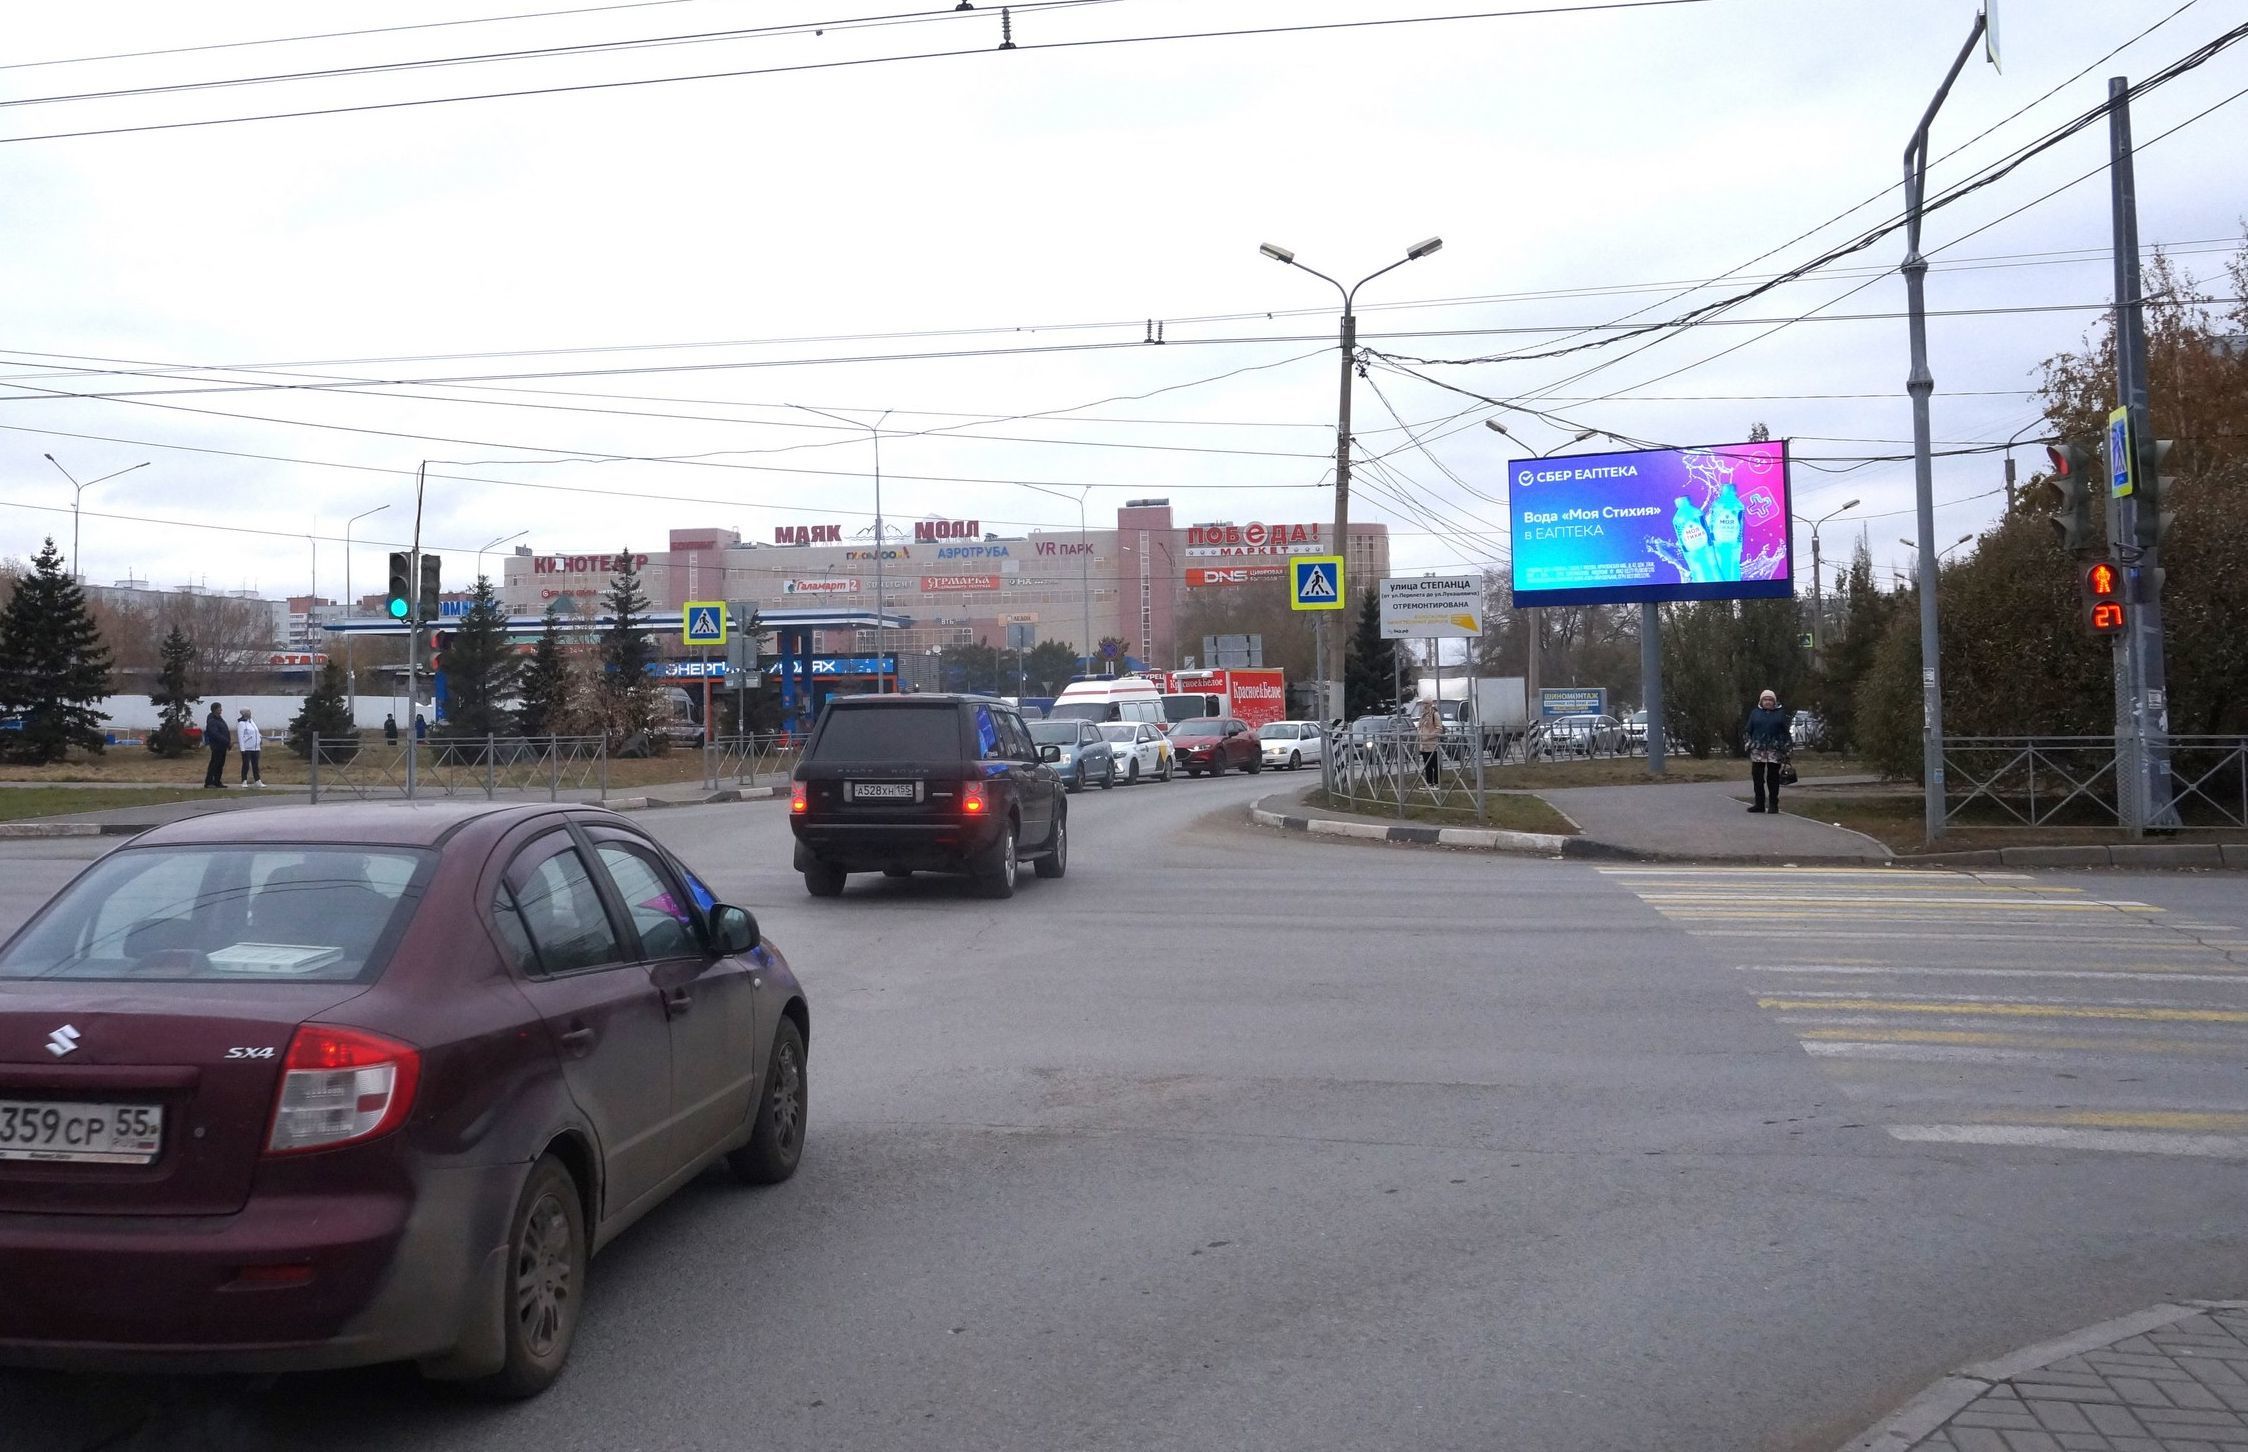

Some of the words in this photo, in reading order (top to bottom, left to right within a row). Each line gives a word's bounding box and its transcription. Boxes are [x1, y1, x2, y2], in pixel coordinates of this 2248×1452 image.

[1536, 471, 1573, 482] СБЕР
[1574, 465, 1638, 480] ЕАПТЕКА
[1523, 511, 1558, 524] Вода
[1562, 508, 1599, 521] «Моя
[1602, 505, 1661, 519] Стихия»
[775, 525, 842, 543] МАЯК
[914, 520, 980, 540] МОЛЛ
[1535, 524, 1605, 540] ЕАПТЕКА
[938, 546, 1009, 559] АЭРОТРУБА
[1035, 542, 1056, 555] VR
[1059, 543, 1094, 555] ПАРК
[1221, 547, 1289, 556] МАРКЕТ
[1204, 570, 1248, 583] DNS
[1390, 584, 1418, 592] улица
[1420, 581, 1471, 590] СТЕПАНЦА
[1392, 602, 1469, 610] ОТРЕМОНТИРОВАНА
[2095, 605, 2122, 627] 27
[1544, 692, 1599, 700] ШИНОМОНТАЖ
[223, 1046, 276, 1060] SX4
[115, 1108, 149, 1137] 55
